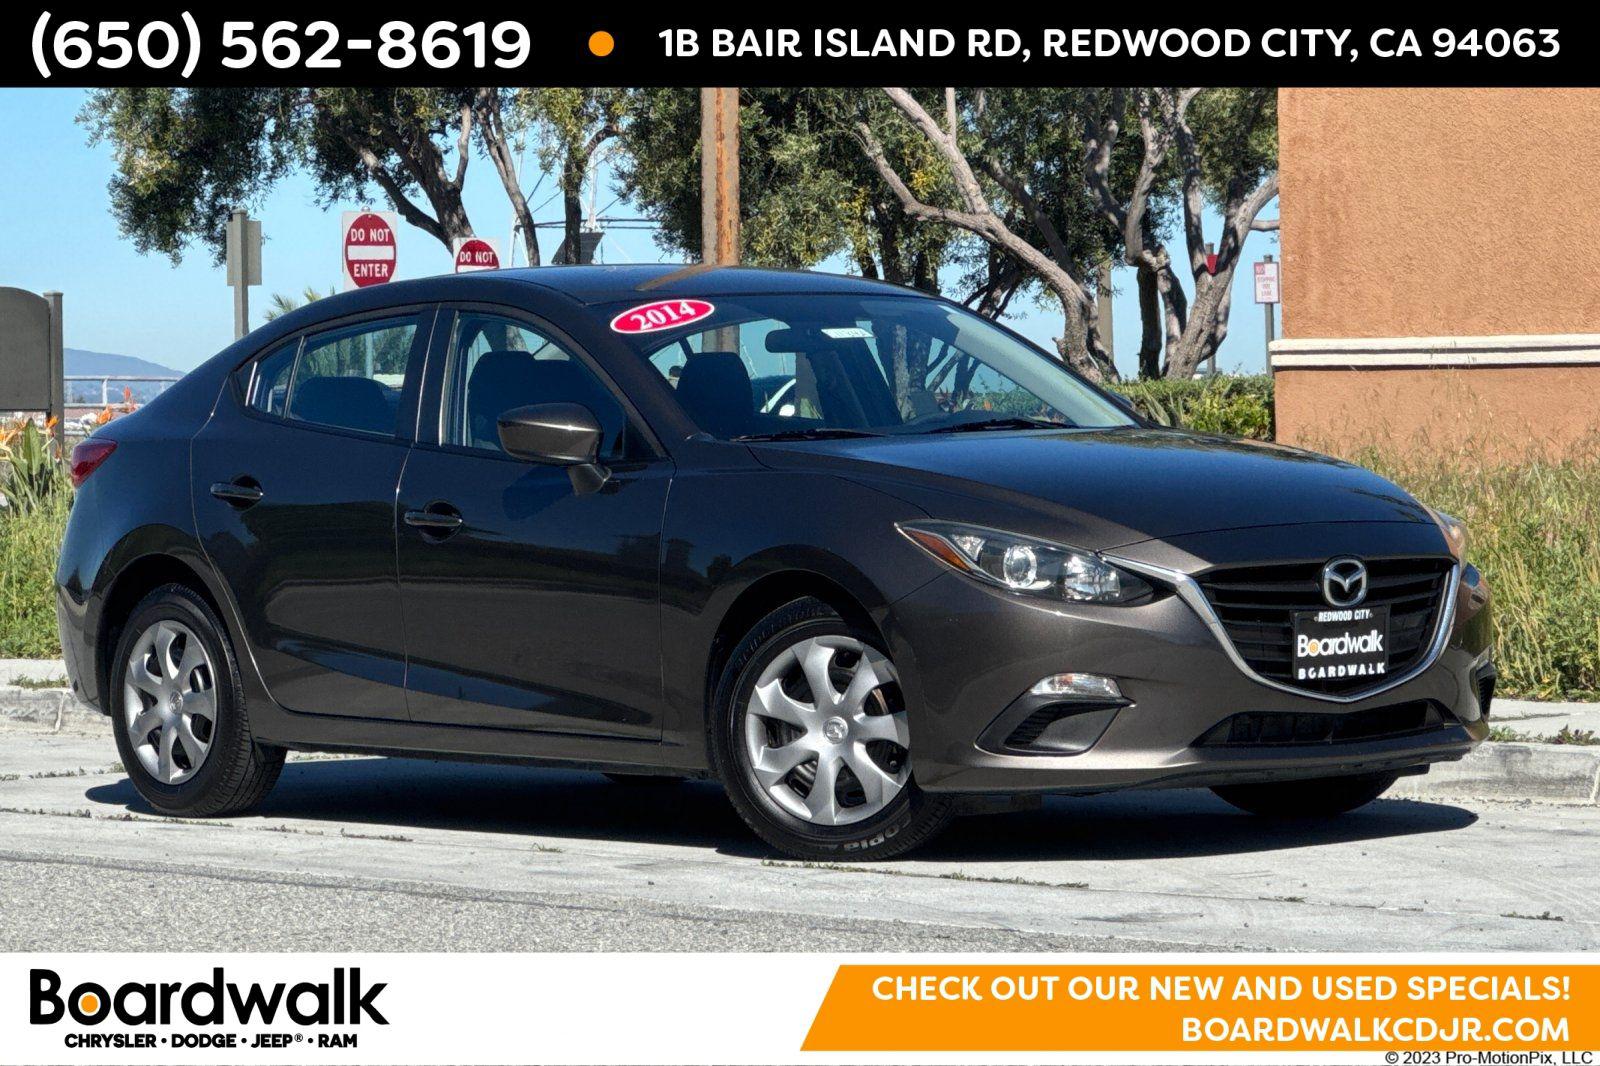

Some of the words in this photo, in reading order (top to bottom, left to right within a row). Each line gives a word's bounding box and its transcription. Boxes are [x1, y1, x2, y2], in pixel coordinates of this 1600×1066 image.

[350, 228, 365, 242] DO
[369, 228, 390, 242] NOT
[459, 251, 472, 263] DO
[475, 251, 494, 263] NOT
[353, 263, 389, 278] ENTER
[630, 299, 697, 331] 2014
[1318, 610, 1352, 622] REDWOOD
[1354, 609, 1371, 621] CITY
[1297, 629, 1384, 658] Boardwalk
[1297, 662, 1386, 680] BOARDWALK
